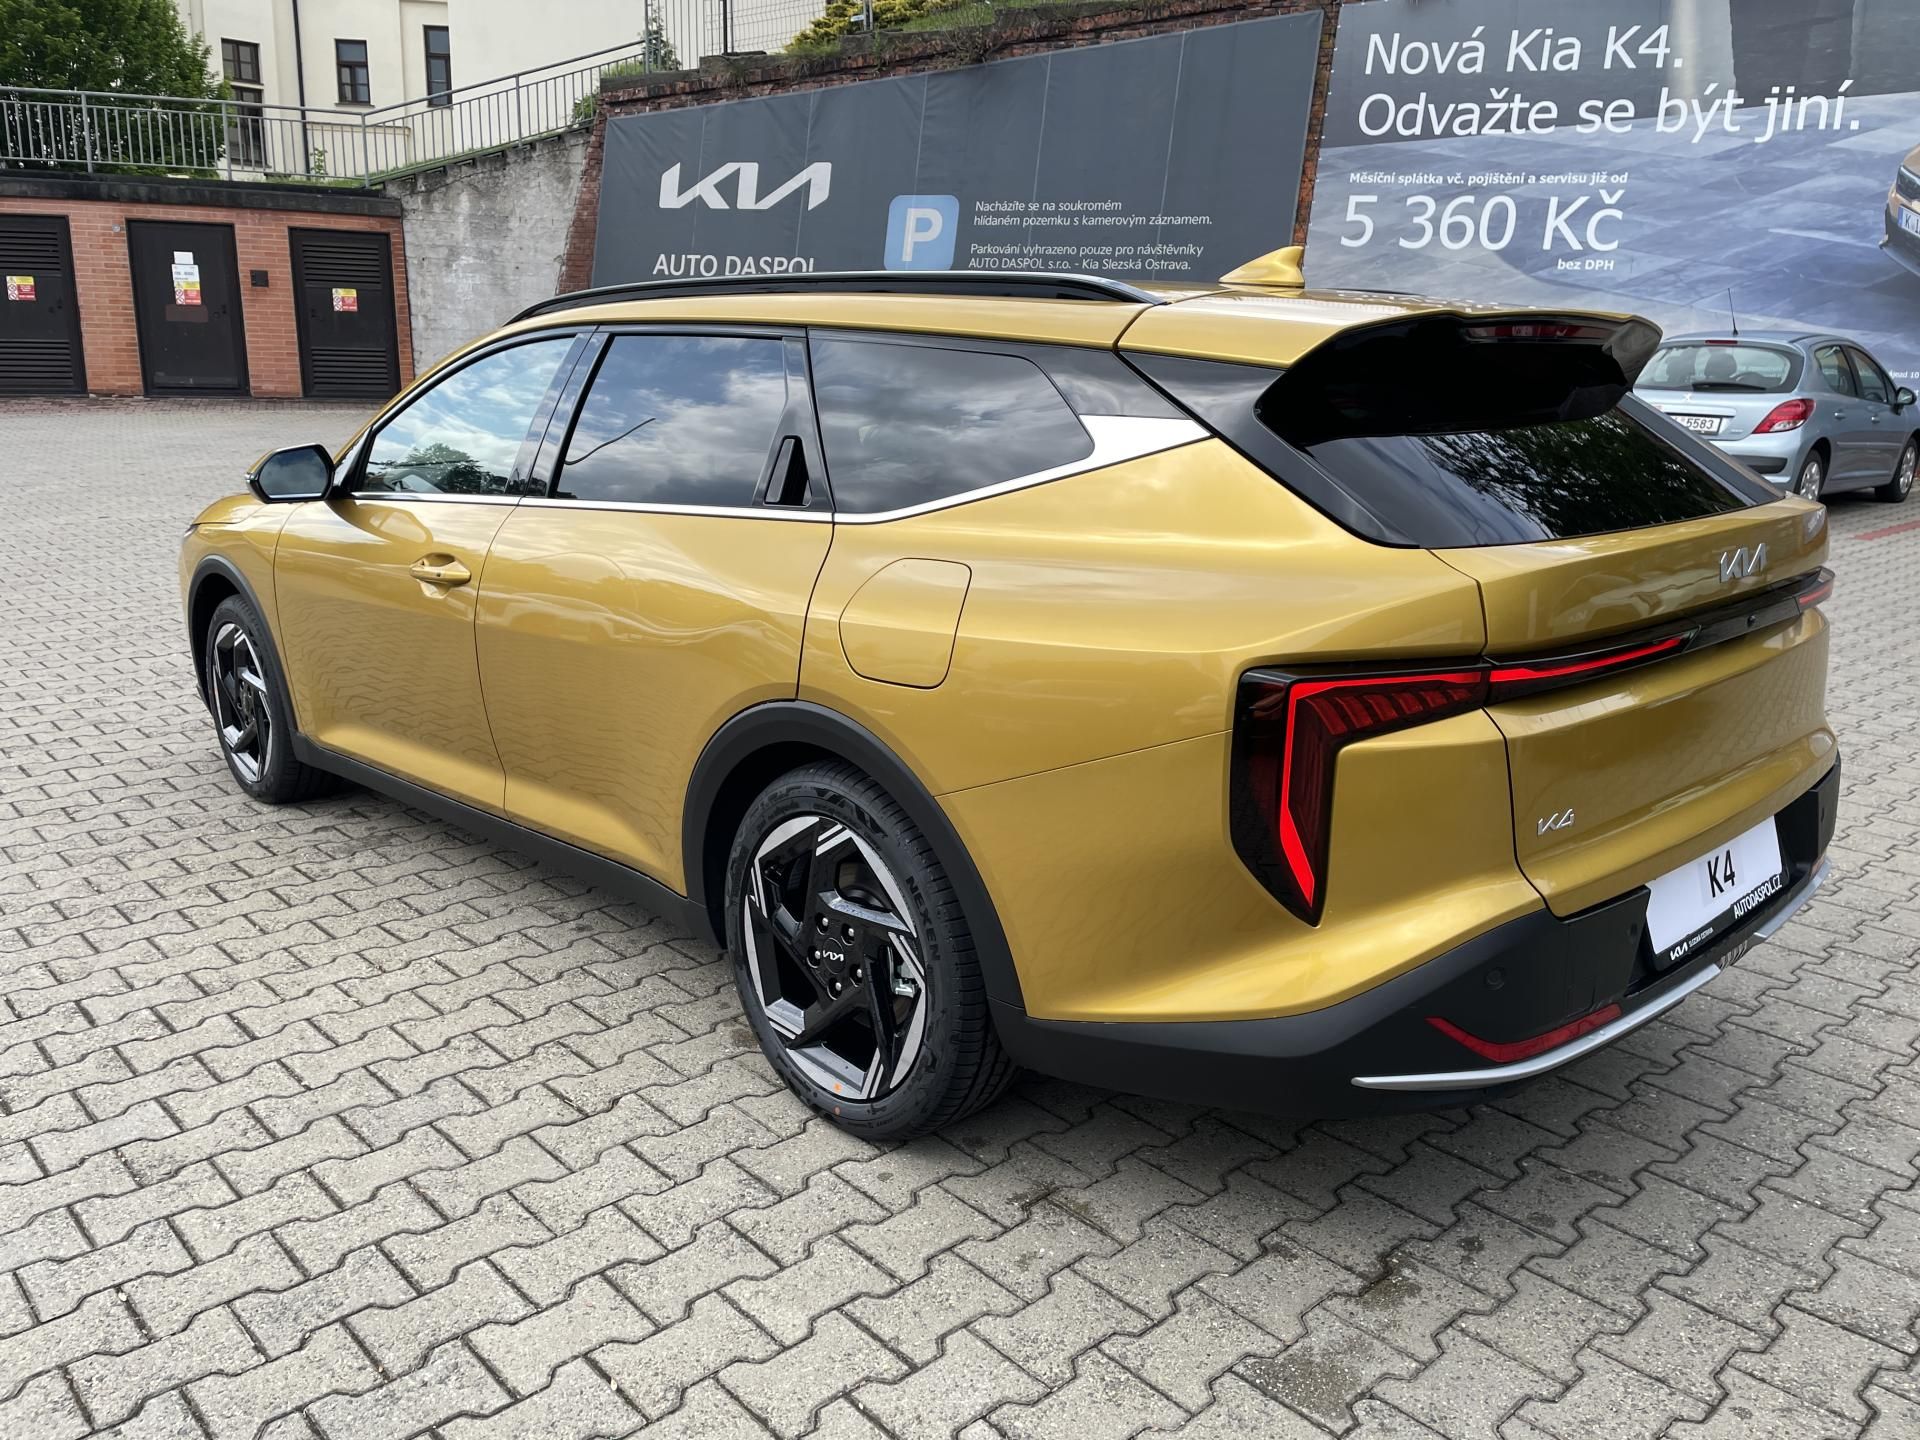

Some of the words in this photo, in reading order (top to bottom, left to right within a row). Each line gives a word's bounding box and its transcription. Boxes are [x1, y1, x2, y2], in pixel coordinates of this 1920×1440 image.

[1365, 26, 1486, 75] Nová
[1506, 28, 1581, 72] Kia
[1604, 24, 1683, 69] K4.
[1358, 87, 1558, 136] Odvažte
[1576, 98, 1635, 134] se
[1656, 82, 1744, 144] být
[1754, 79, 1860, 143] jiní.
[659, 161, 832, 211] KIA
[1350, 172, 1395, 183] Měsíční
[1398, 173, 1443, 186] splátka
[1447, 174, 1464, 184] vč.
[1468, 172, 1524, 186] pojištění
[1528, 175, 1536, 184] a
[1539, 174, 1585, 184] servisu
[1589, 172, 1607, 186] již
[1611, 172, 1628, 184] od
[974, 215, 1020, 226] hlídaném
[1023, 215, 1070, 228] pozemku
[1073, 217, 1079, 225] s
[1082, 215, 1146, 228] kamerovým
[1149, 214, 1213, 225] záznamem.
[976, 201, 1025, 212] Nacházíte
[1028, 203, 1039, 211] se
[1043, 203, 1055, 211] na
[1058, 200, 1122, 211] soukromém
[1340, 195, 1378, 247] 5
[1398, 195, 1516, 250] 360
[1543, 189, 1625, 251] Kč
[902, 208, 943, 261] P
[970, 243, 1021, 254] Parkování
[1023, 243, 1077, 257] vyhrazeno
[1080, 246, 1112, 257] pouze
[1115, 246, 1134, 257] pro
[1137, 243, 1204, 257] návštěvníky
[652, 253, 717, 276] AUTO
[968, 258, 999, 269] AUTO
[1001, 258, 1044, 269] DASPOL
[1048, 260, 1071, 269] s.r.o.
[1082, 259, 1099, 269] Kia
[1102, 258, 1141, 270] Slezská
[1145, 259, 1191, 270] Ostrava.
[1557, 259, 1581, 270] bez
[1584, 260, 1614, 271] DPH
[1720, 543, 1766, 583] KIA
[1537, 808, 1574, 837] K4
[1707, 849, 1735, 898] K4
[905, 876, 940, 961] NEXEN
